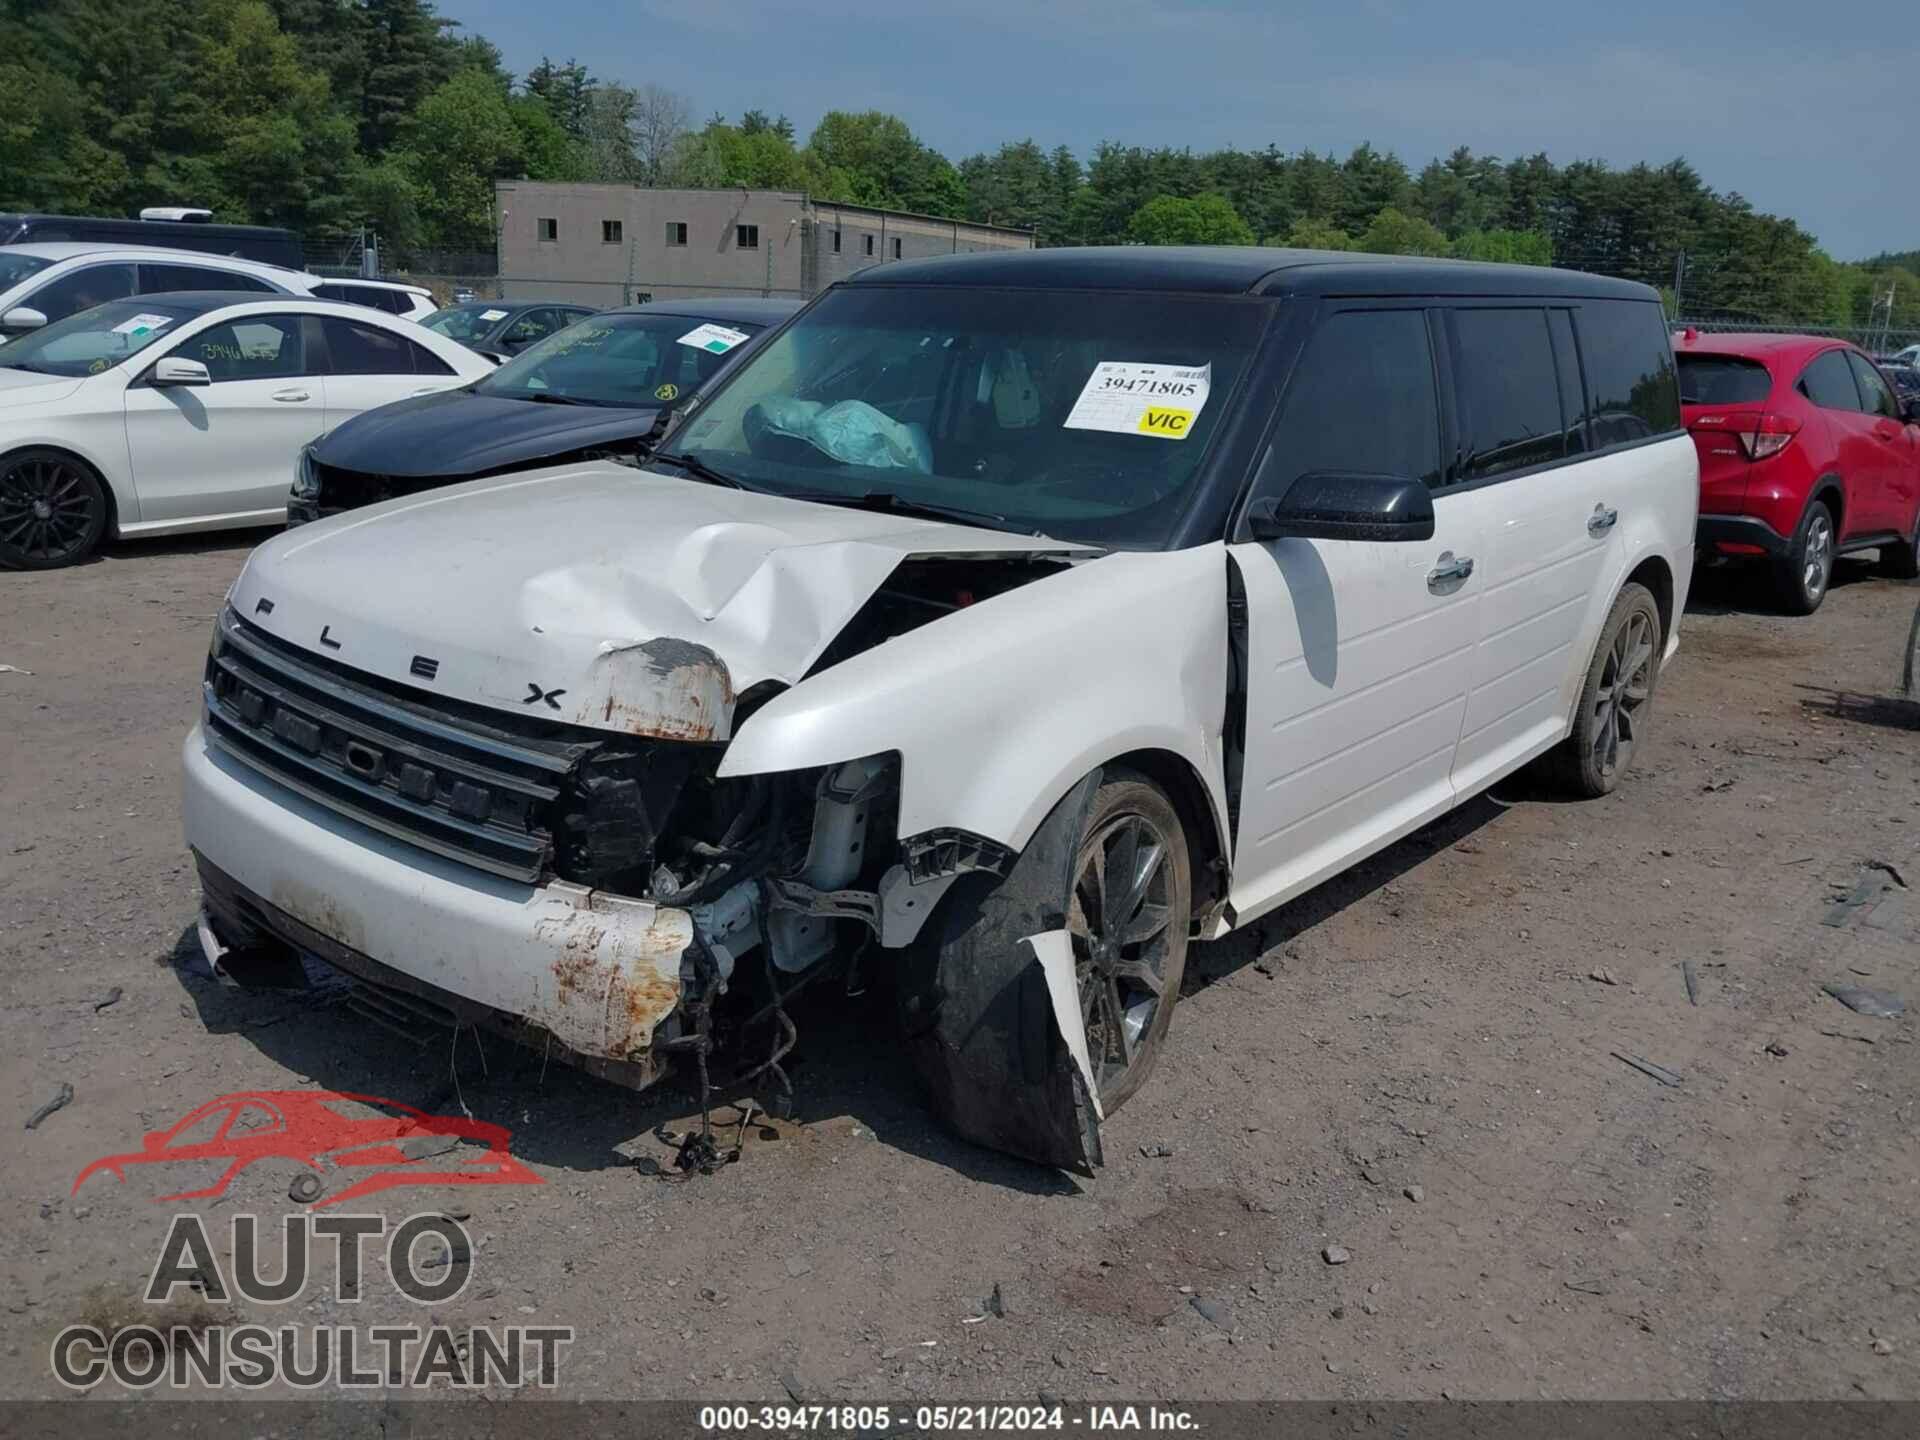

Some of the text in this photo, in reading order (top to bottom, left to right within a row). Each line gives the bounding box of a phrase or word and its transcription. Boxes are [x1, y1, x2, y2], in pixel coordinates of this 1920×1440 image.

[1099, 377, 1197, 397] 39471805
[1148, 412, 1187, 430] VIC
[255, 598, 567, 711] FLEX
